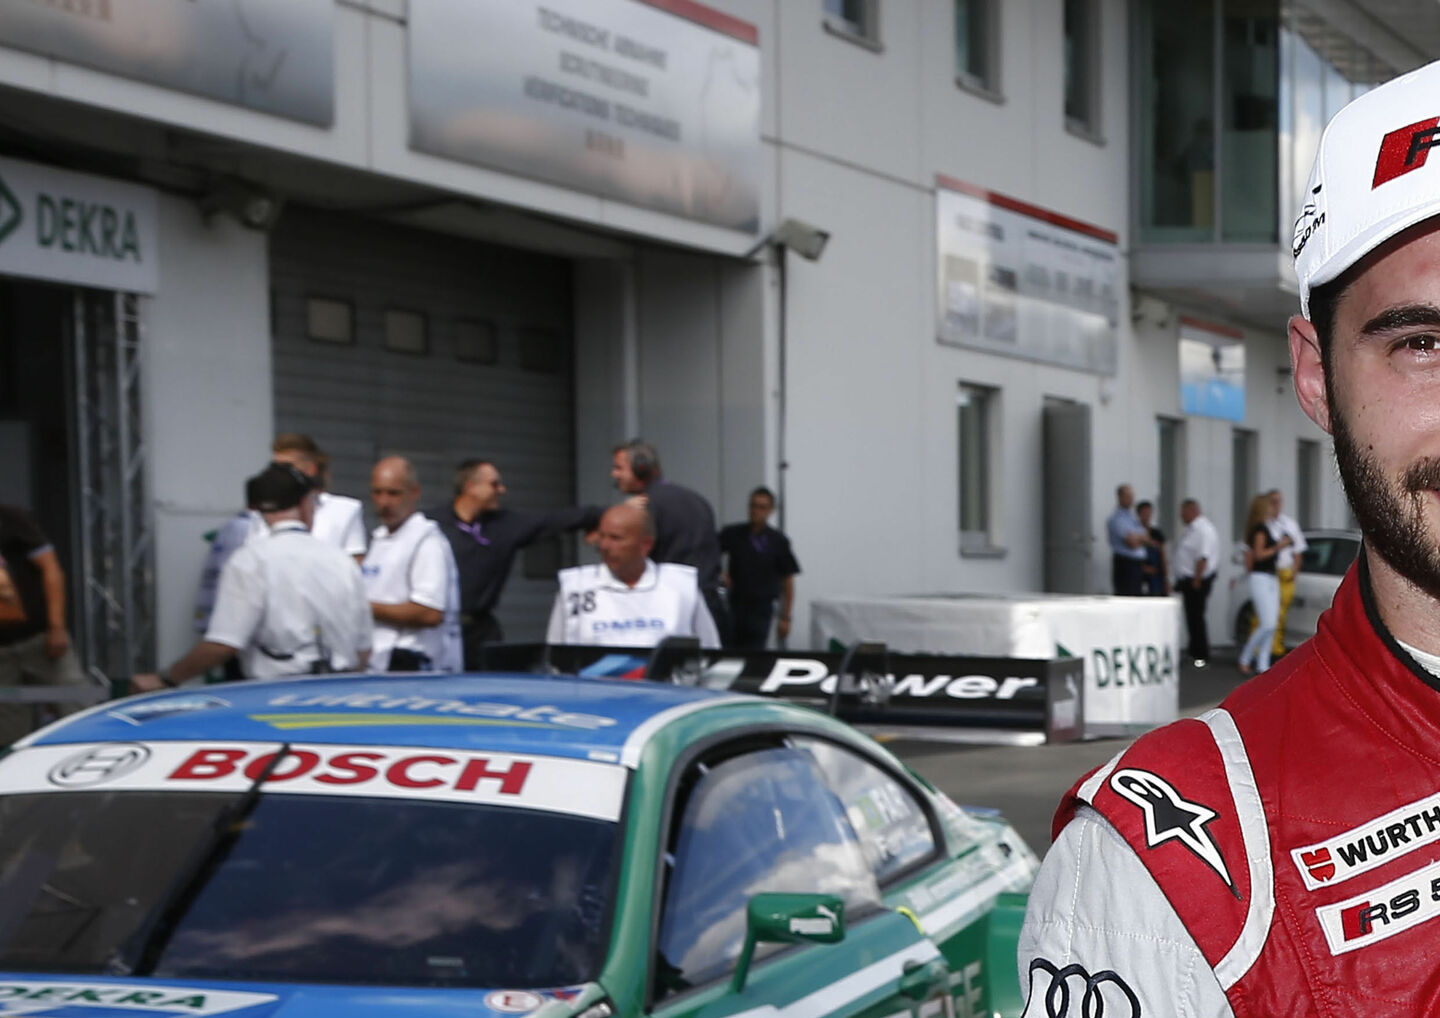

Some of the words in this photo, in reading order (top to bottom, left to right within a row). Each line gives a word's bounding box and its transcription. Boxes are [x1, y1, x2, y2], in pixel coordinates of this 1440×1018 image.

[36, 192, 143, 264] DEKRA
[1093, 644, 1172, 687] DEKRA
[166, 748, 533, 795] BOSCH
[1358, 884, 1421, 935] RS
